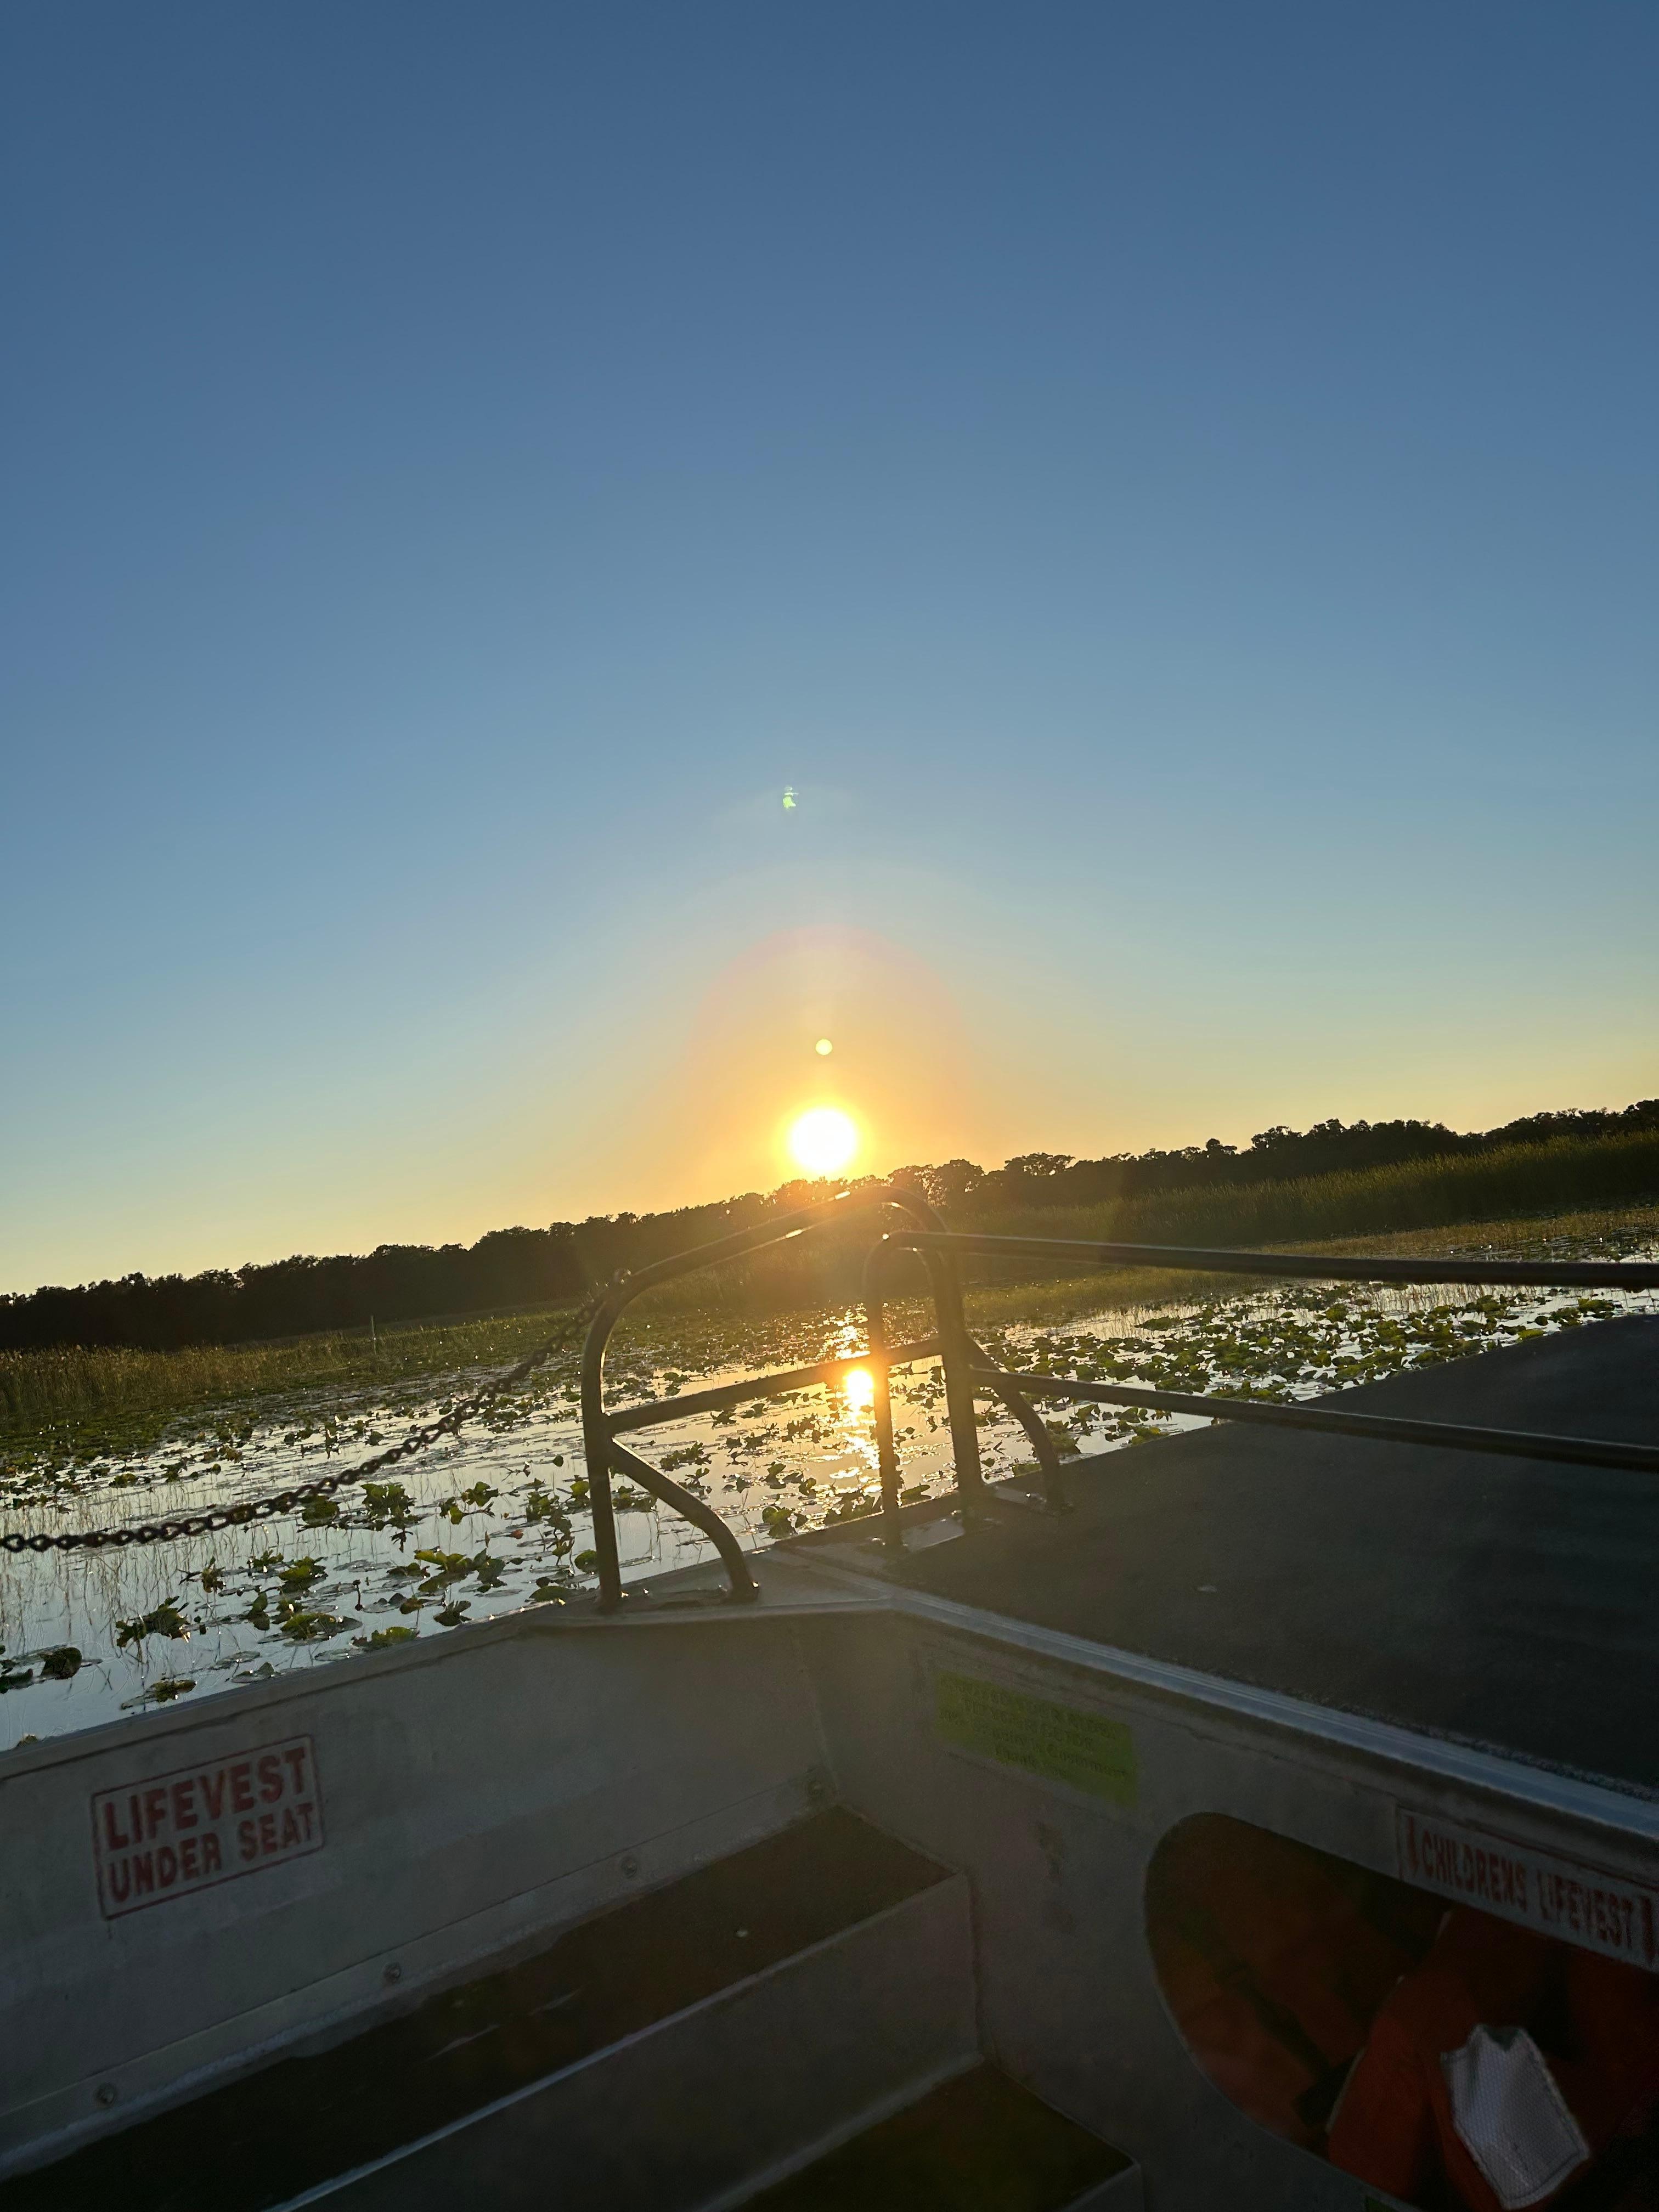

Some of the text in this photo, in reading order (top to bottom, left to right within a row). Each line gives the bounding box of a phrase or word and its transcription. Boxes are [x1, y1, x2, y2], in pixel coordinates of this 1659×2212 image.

[104, 1746, 305, 1851] LIFEVEST
[109, 1802, 313, 1903] UNDER SEAT
[1421, 1829, 1634, 1950] CHILDRENS LIFEVEST
